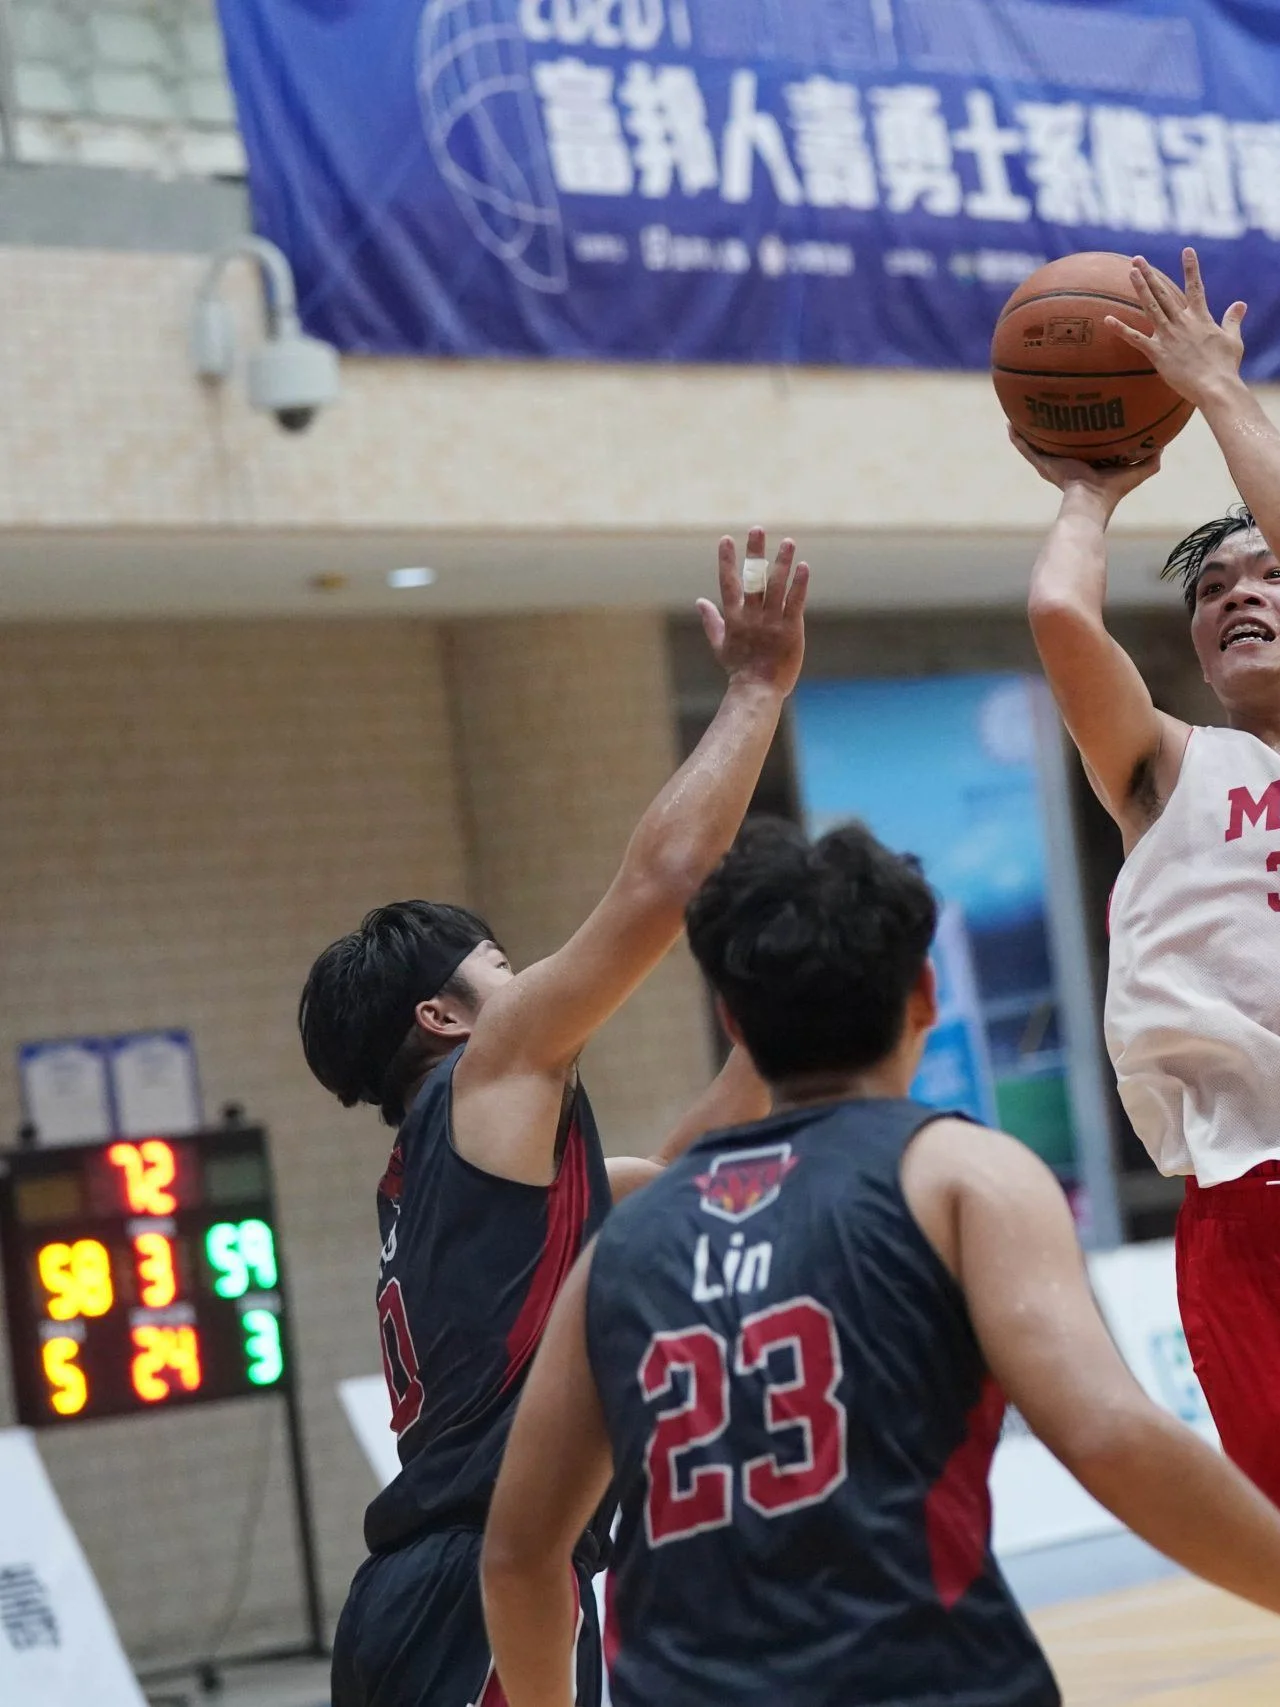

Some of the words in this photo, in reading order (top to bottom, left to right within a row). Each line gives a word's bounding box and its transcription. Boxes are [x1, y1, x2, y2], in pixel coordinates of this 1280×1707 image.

[134, 1232, 176, 1308] 3
[692, 1232, 773, 1302] Lin
[42, 1335, 87, 1416] 5
[242, 1308, 283, 1386] 3
[639, 1296, 847, 1549] 23
